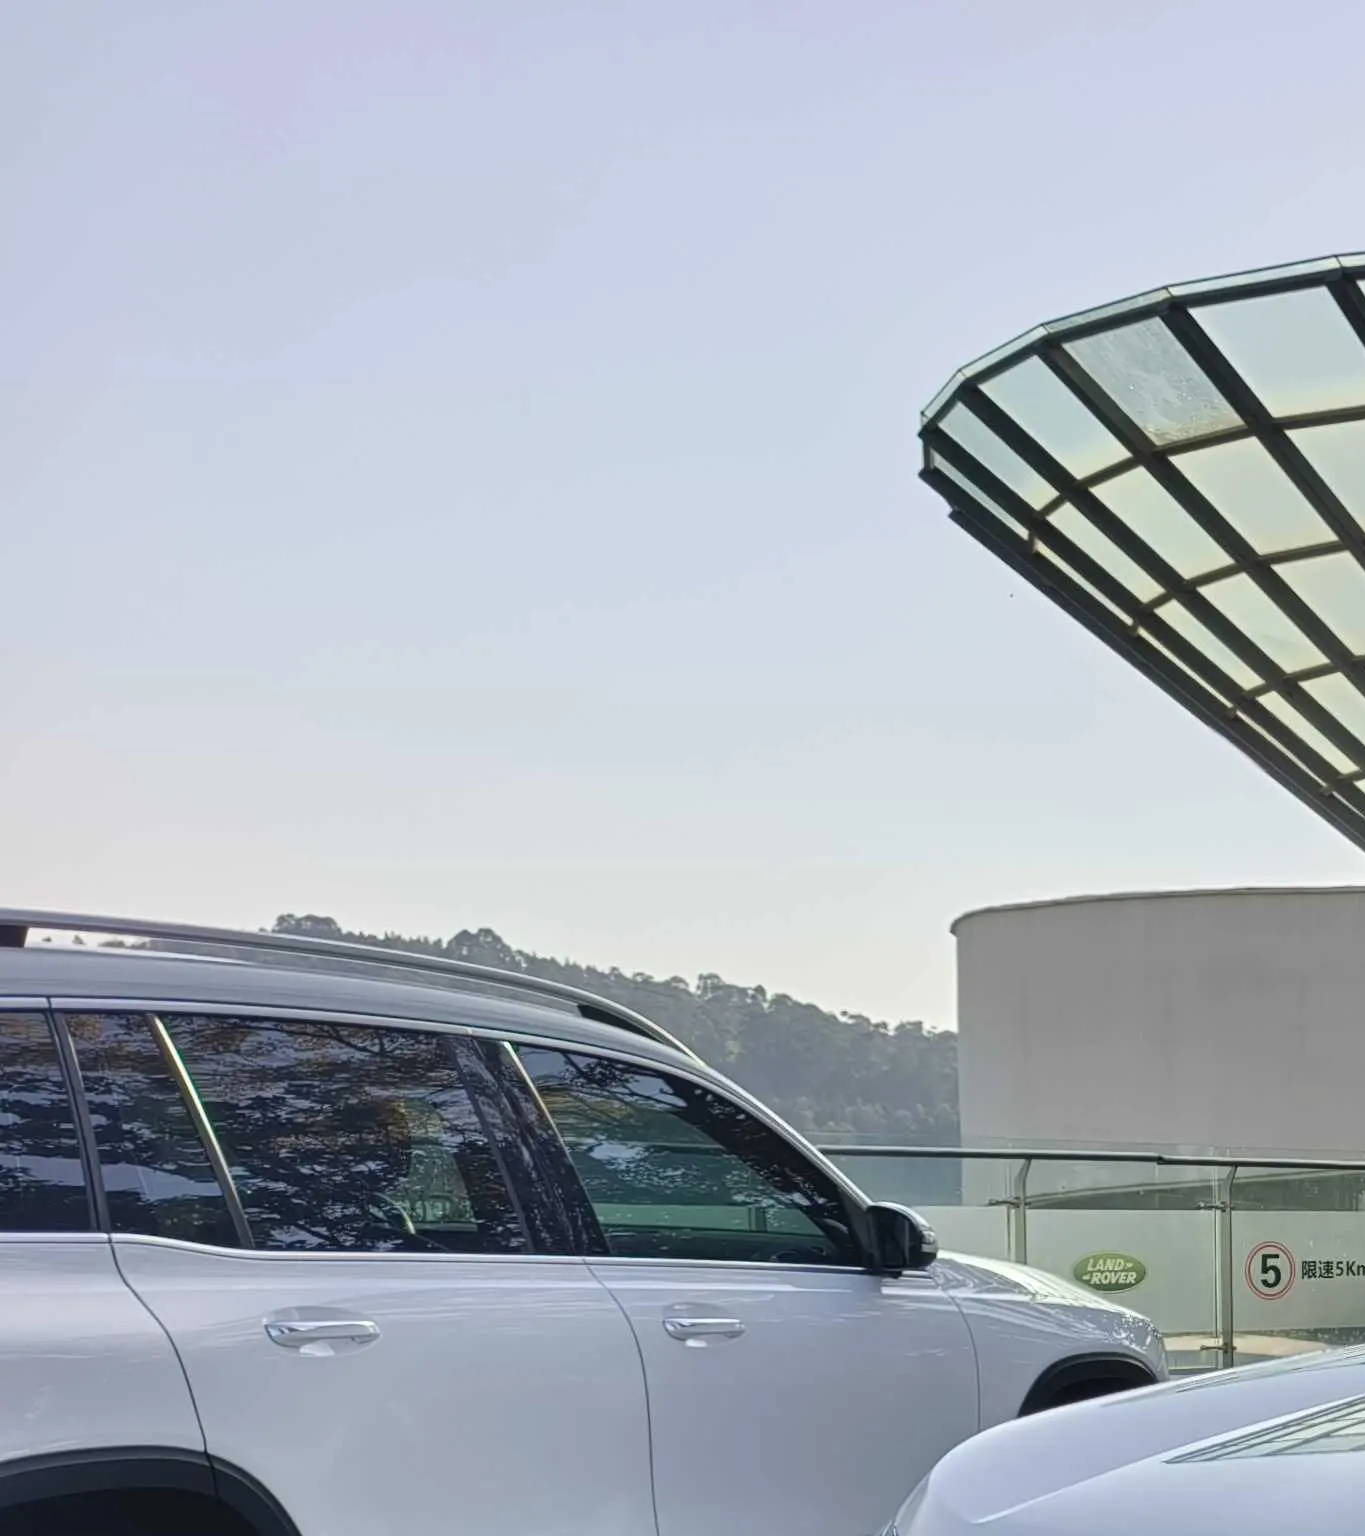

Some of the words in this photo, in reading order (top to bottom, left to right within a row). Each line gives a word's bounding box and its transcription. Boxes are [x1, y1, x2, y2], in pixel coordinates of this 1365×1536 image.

[1087, 1258, 1125, 1271] LAND
[1260, 1253, 1282, 1289] 5
[1090, 1271, 1137, 1284] ROVER
